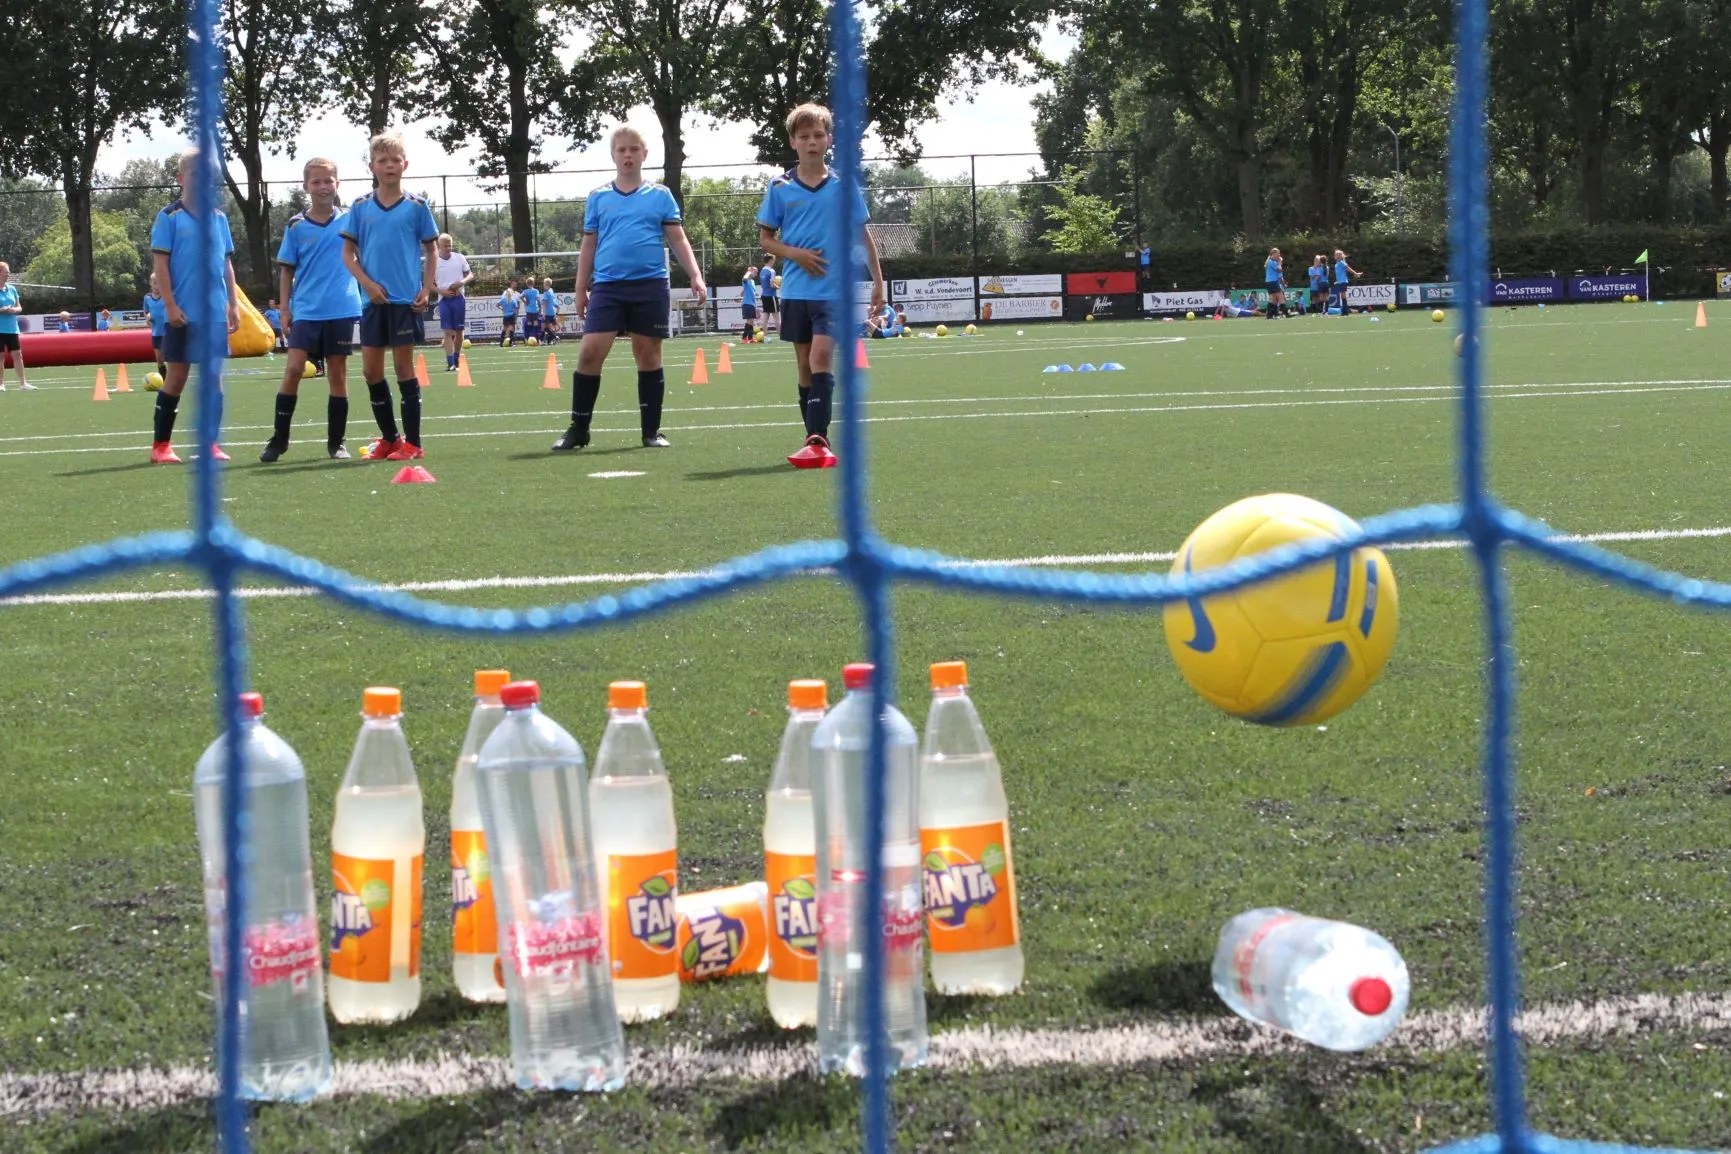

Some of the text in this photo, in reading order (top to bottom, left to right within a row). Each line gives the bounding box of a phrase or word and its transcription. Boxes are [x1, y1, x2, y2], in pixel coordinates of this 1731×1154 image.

[937, 286, 972, 294] Vondevoort
[1508, 286, 1553, 294] KASTEREN
[1592, 283, 1637, 291] KASTEREN
[1009, 298, 1047, 308] BARBIER
[1187, 297, 1203, 305] Gas
